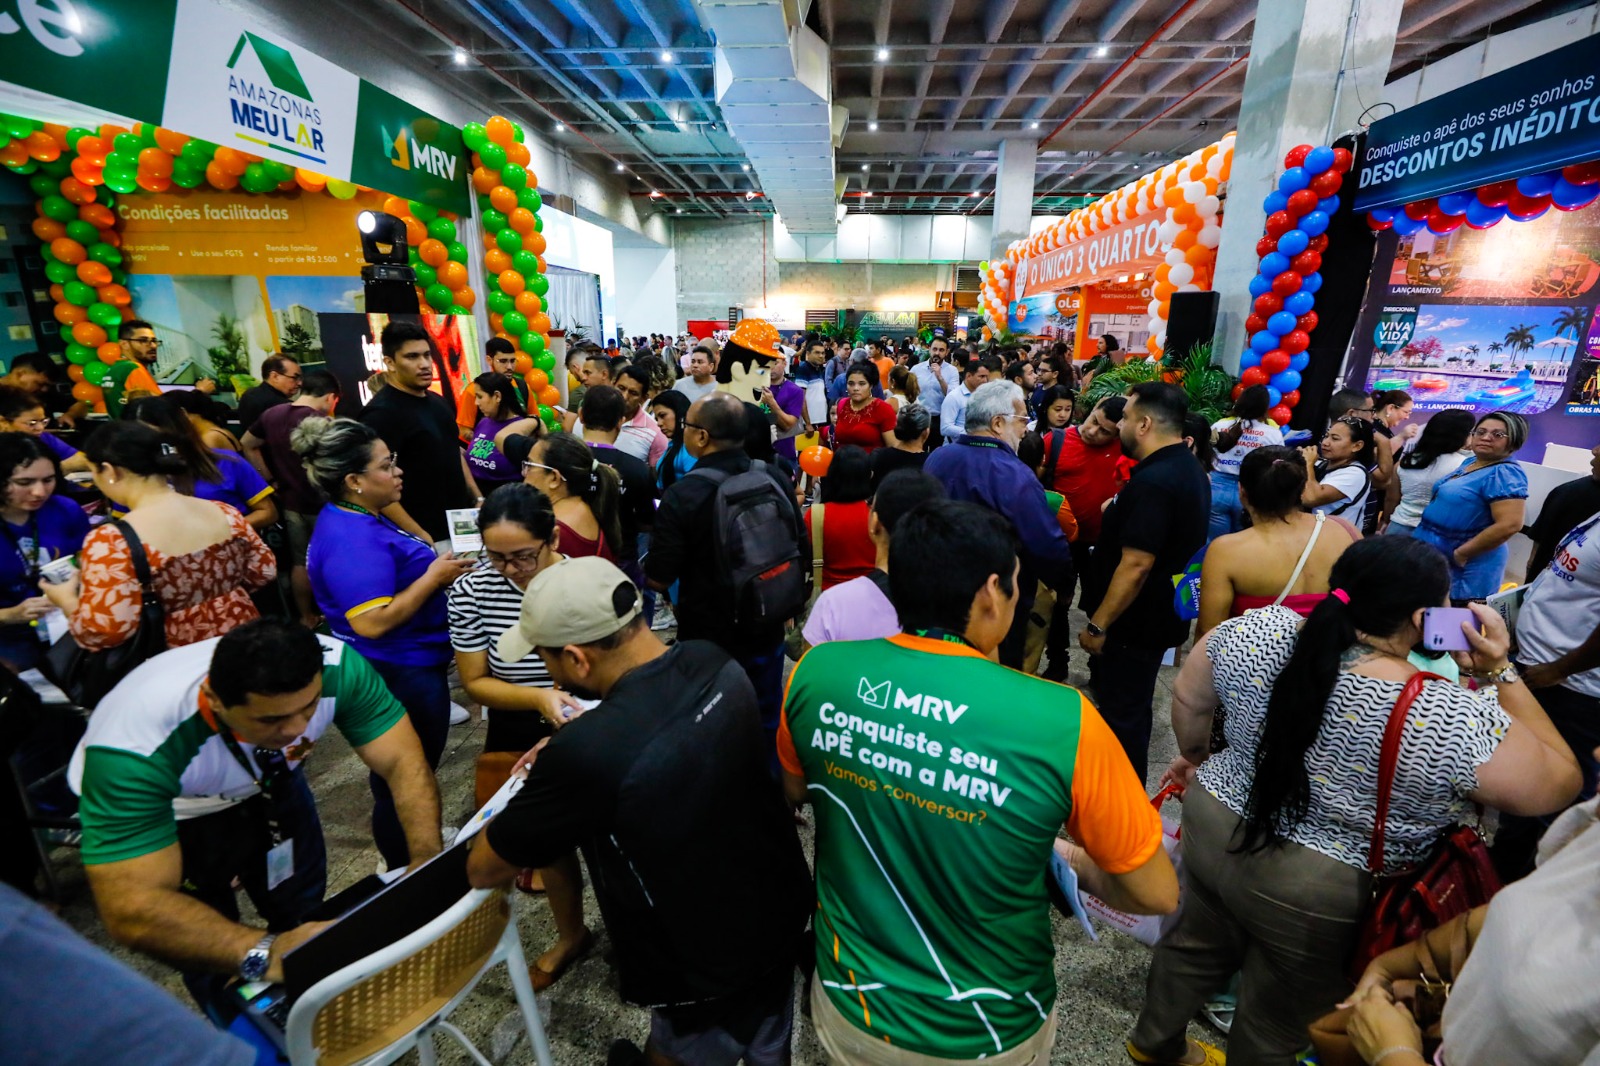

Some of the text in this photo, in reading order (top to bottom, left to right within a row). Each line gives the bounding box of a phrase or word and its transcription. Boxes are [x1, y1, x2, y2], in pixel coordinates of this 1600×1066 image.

[228, 75, 321, 125] AMAZONAS
[1367, 74, 1595, 161] Conquiste o apê dos seus sonhos
[230, 98, 325, 153] MEU LAR
[411, 137, 457, 181] MRV
[1359, 132, 1485, 189] DESCONTOS
[118, 204, 289, 223] Condições facilitadas
[274, 256, 294, 264] partir
[306, 255, 317, 264] R$
[1031, 264, 1038, 286] O
[1040, 250, 1073, 283] ÚNICO
[1076, 245, 1084, 273] 3
[1088, 219, 1172, 275] QUARTO
[1392, 287, 1441, 295] LANÇAMENTO
[1379, 331, 1409, 340] VIDA
[1381, 322, 1411, 331] VIVA
[894, 687, 969, 724] MRV
[818, 702, 998, 776] Conquiste seu
[811, 728, 1012, 808] APÊ com a MRV
[824, 760, 987, 826] Vamos conversar?
